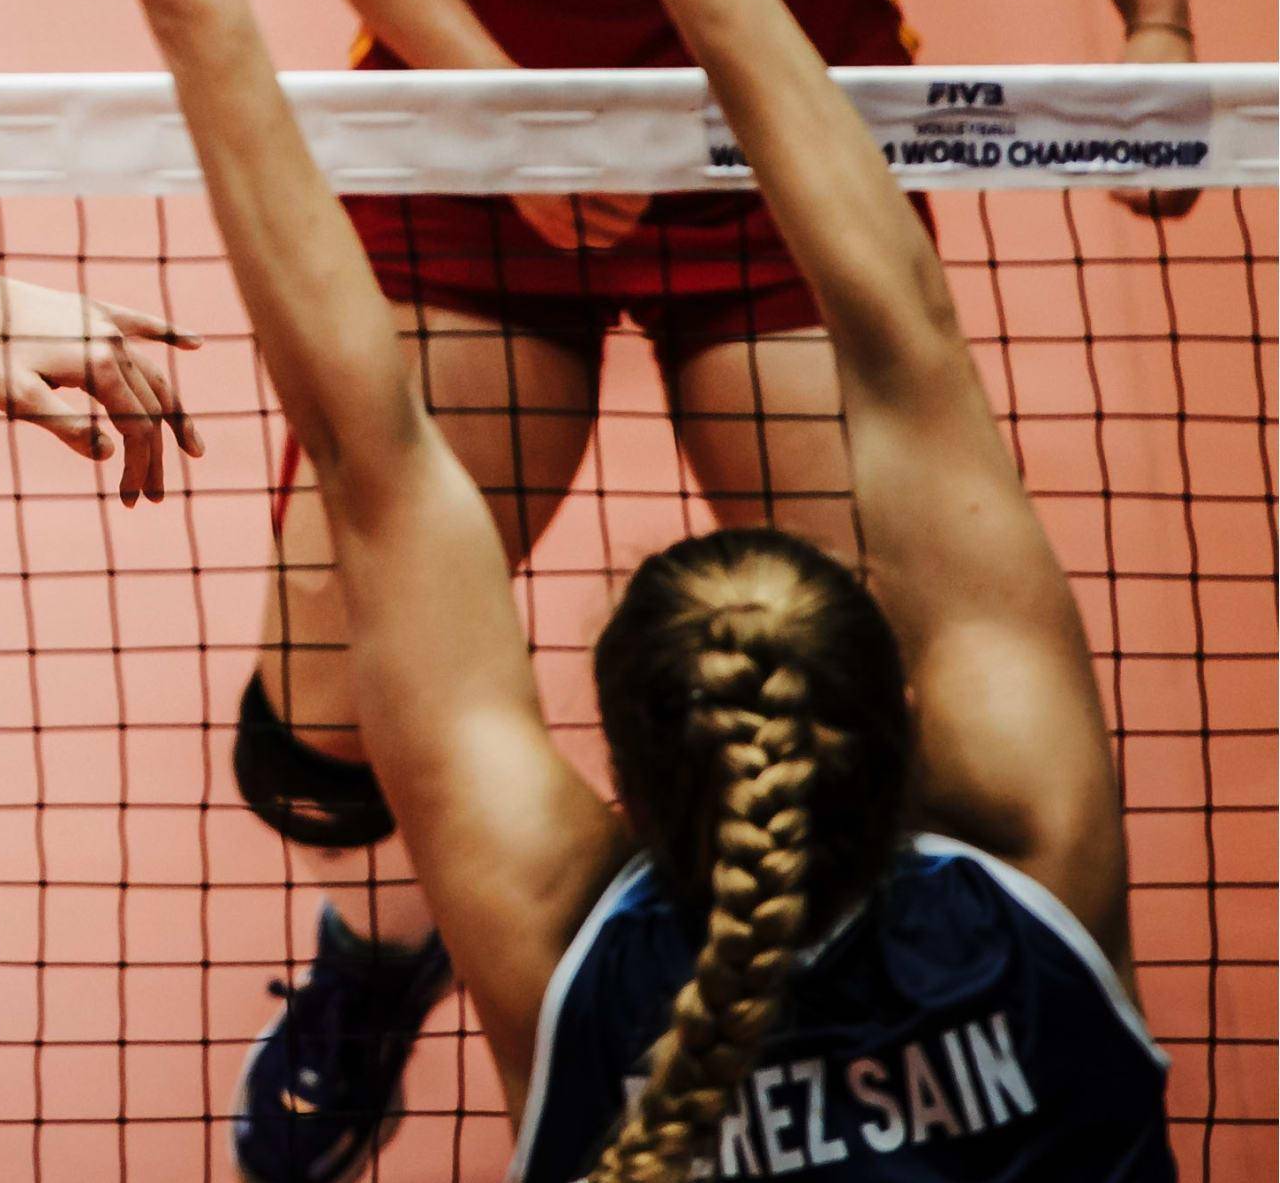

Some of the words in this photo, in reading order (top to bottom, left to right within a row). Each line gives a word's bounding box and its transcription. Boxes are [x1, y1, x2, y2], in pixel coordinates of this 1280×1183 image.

[901, 141, 1000, 167] WORLD
[1007, 140, 1208, 168] CHAMPIONSHIP
[690, 1059, 848, 1178] REZ
[847, 1012, 1036, 1153] SAIN
